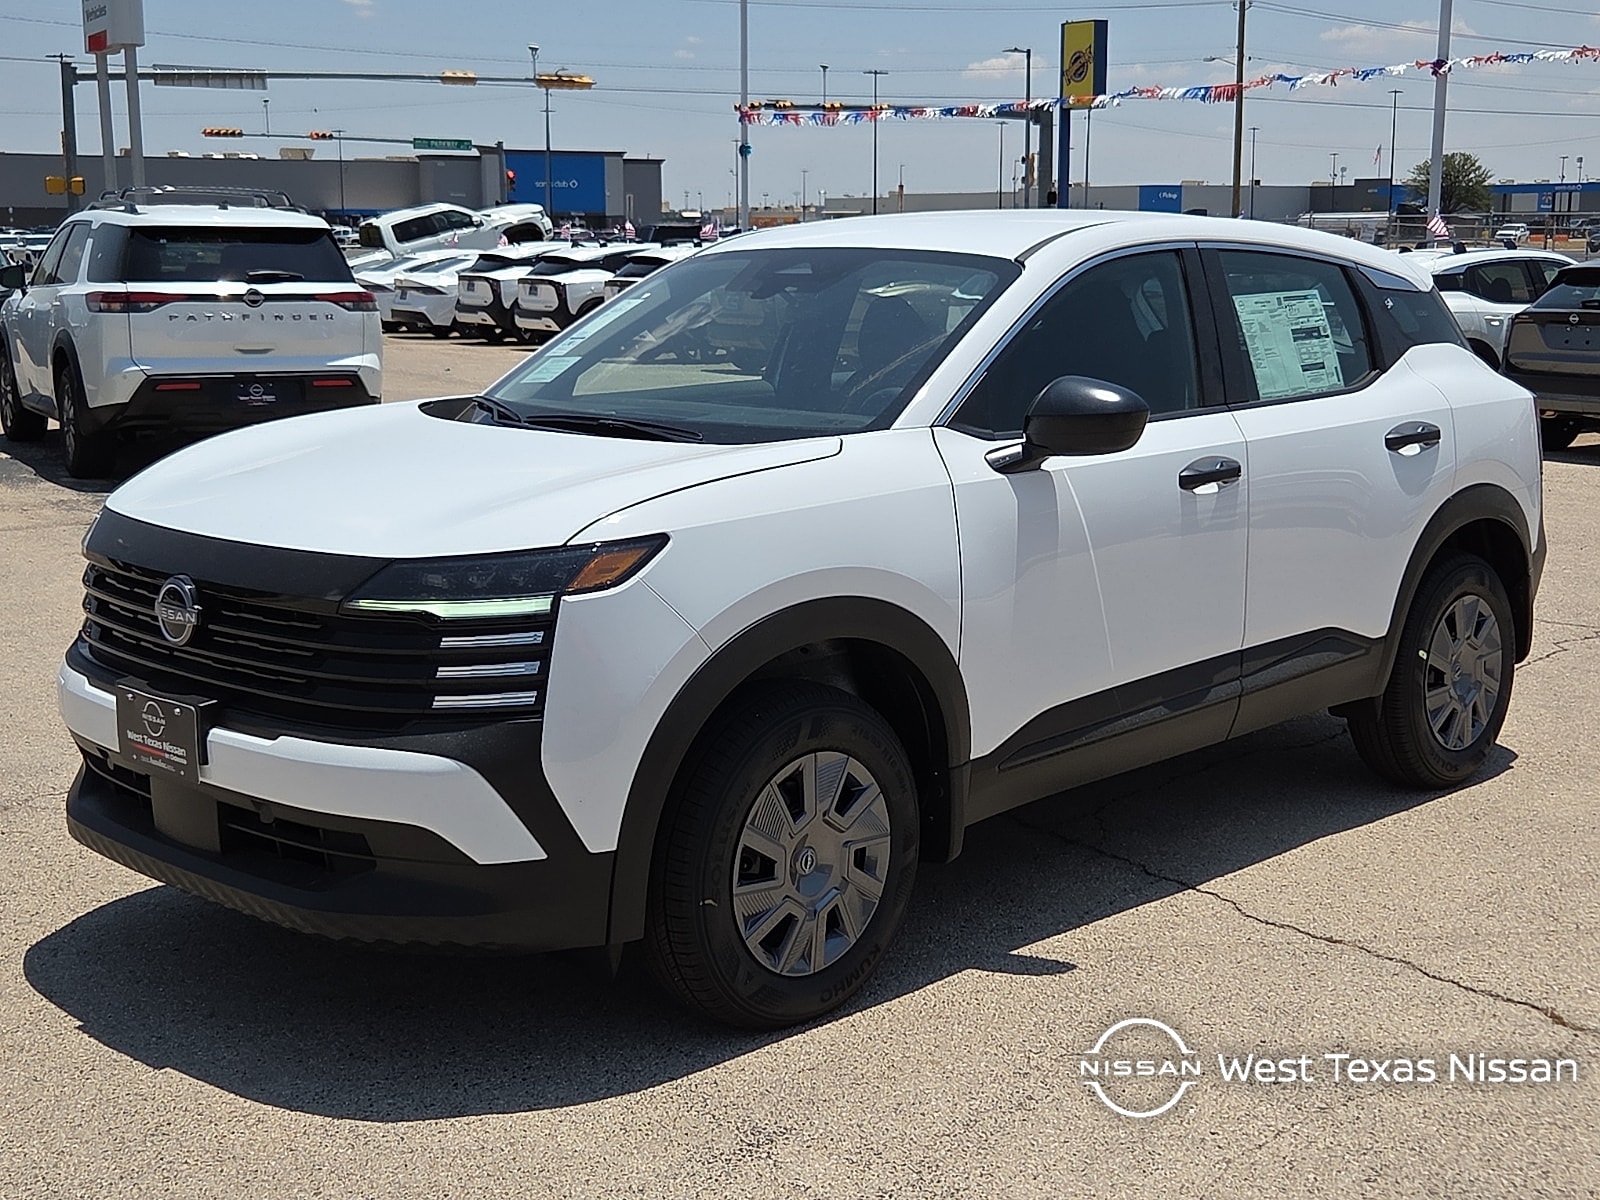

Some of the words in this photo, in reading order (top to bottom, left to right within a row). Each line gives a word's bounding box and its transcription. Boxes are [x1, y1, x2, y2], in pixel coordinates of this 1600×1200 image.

[126, 729, 143, 743] West
[143, 735, 162, 750] Texas
[163, 741, 187, 757] Nissan
[820, 943, 881, 1003] KUMHO
